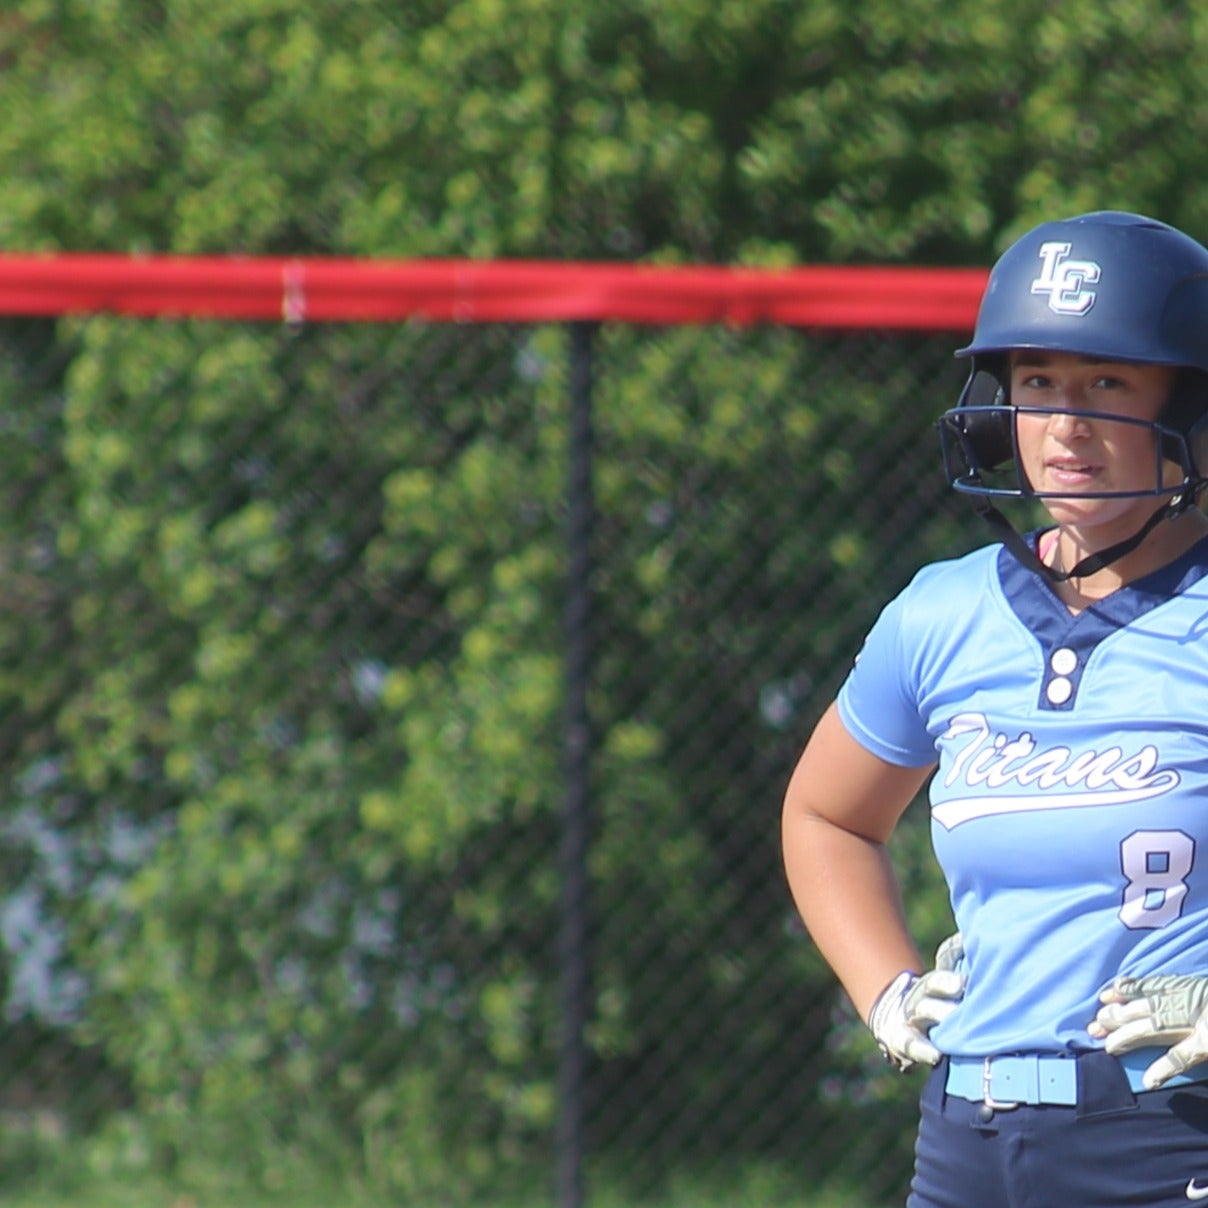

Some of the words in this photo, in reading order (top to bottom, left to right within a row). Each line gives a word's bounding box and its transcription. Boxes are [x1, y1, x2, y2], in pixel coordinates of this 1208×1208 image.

[1030, 241, 1102, 317] LC
[941, 712, 1182, 792] Titans
[1118, 828, 1197, 930] 8
